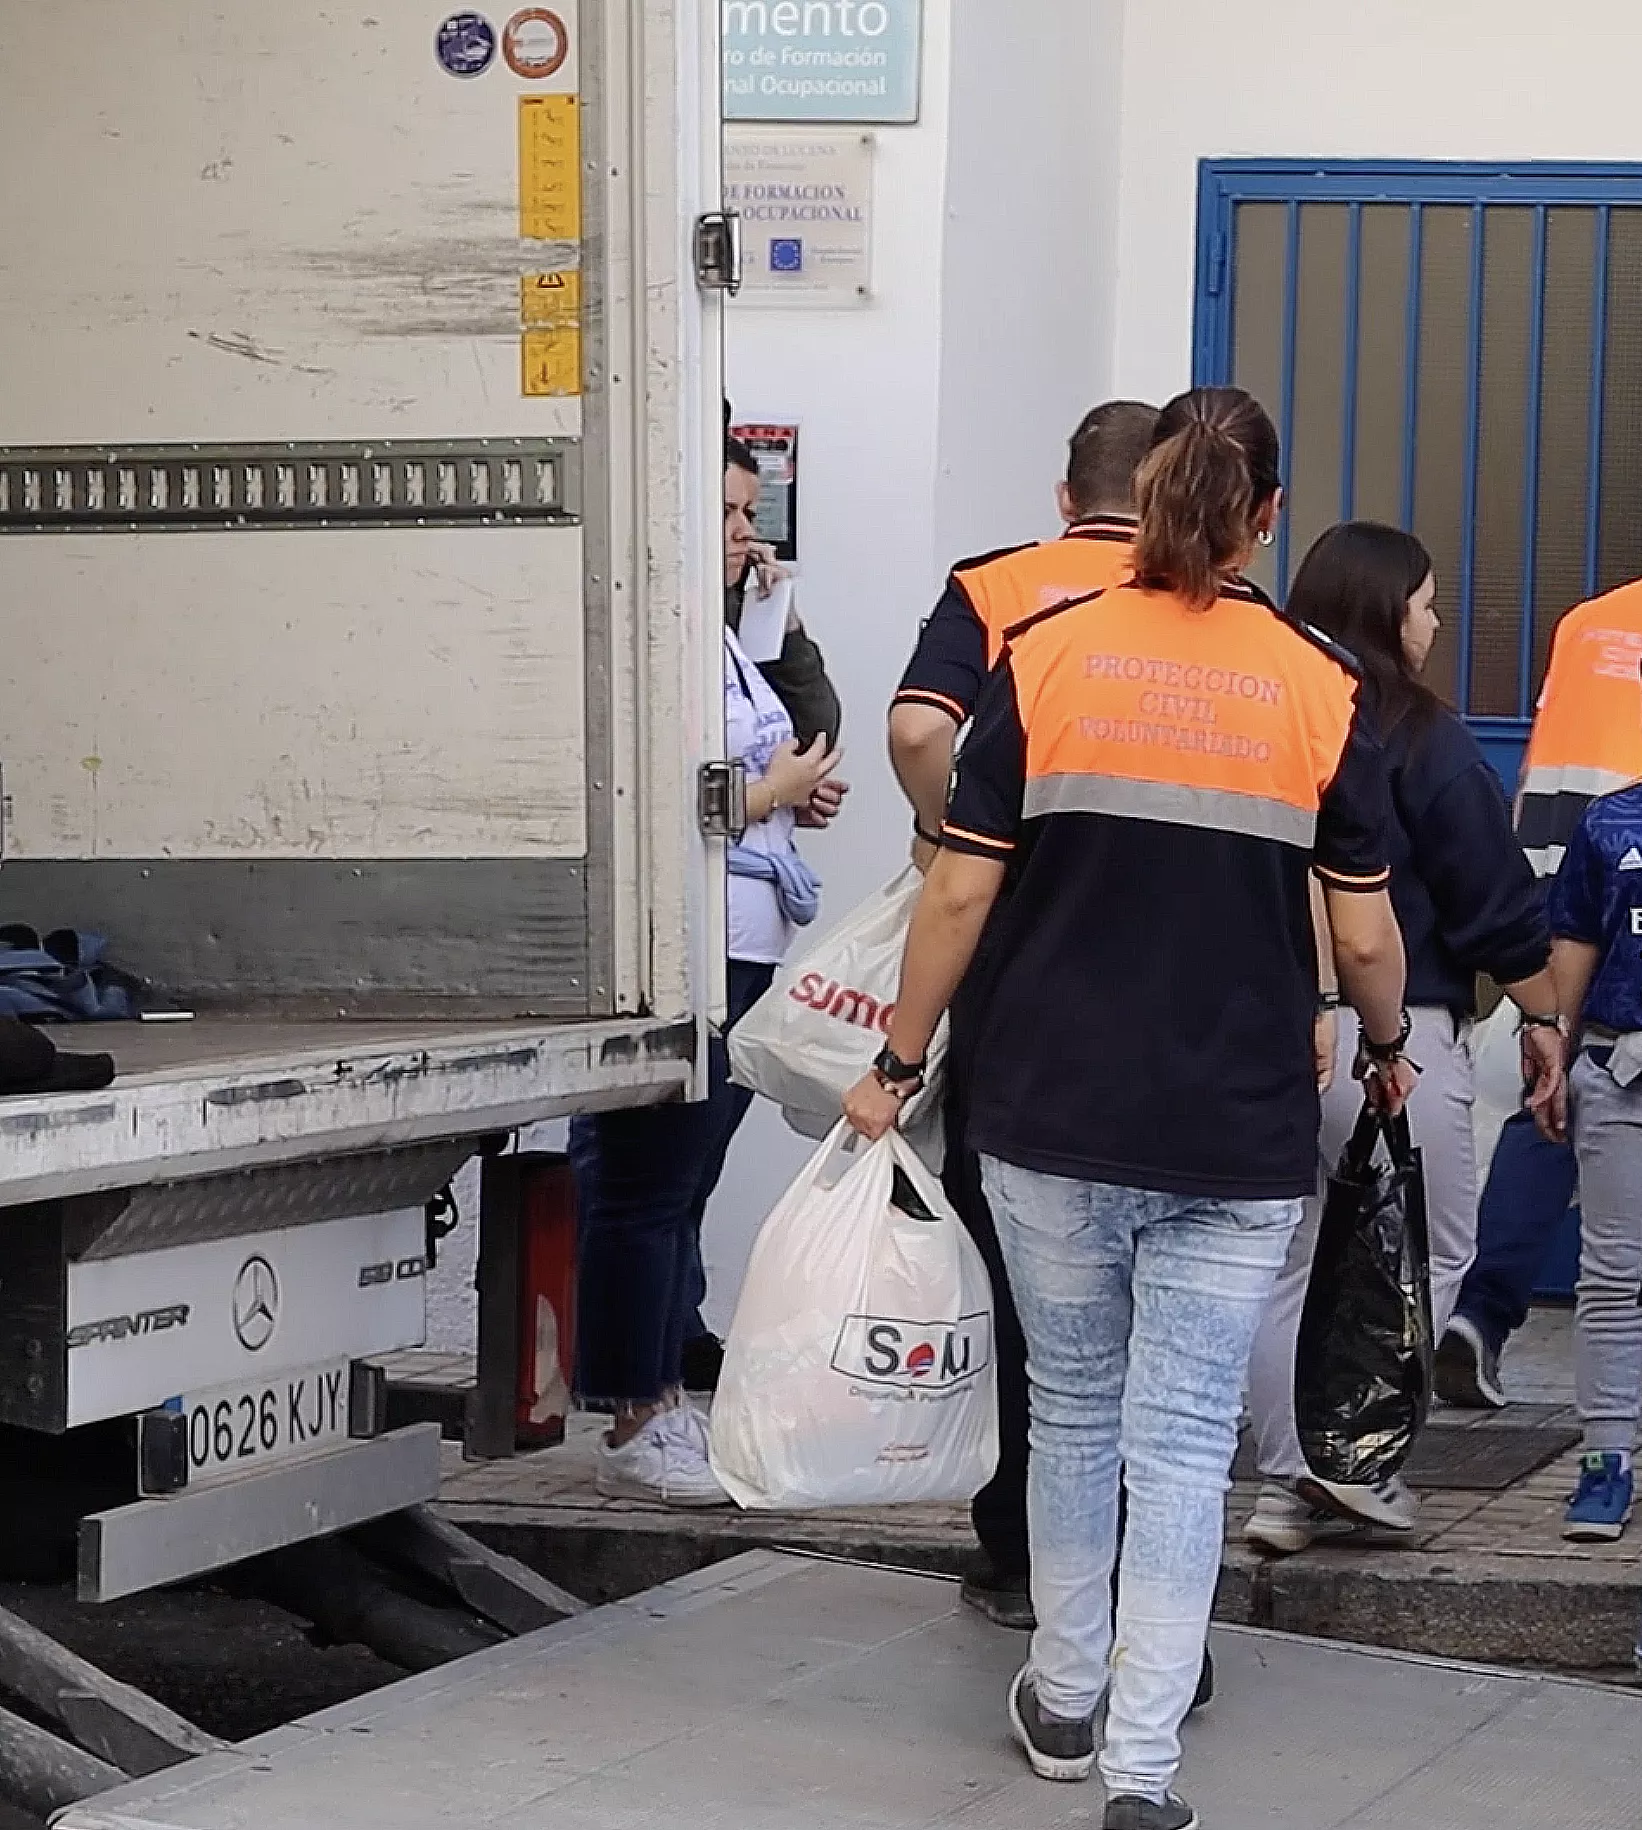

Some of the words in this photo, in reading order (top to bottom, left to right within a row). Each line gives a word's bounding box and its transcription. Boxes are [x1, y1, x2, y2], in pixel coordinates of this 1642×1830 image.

[750, 45, 777, 67] de
[780, 45, 888, 67] Formación
[760, 73, 888, 99] Ocupacional
[744, 183, 845, 200] FORMACION
[743, 206, 863, 221] OCUPACIONAL
[1083, 654, 1283, 706] PROTECCION
[1138, 690, 1218, 725] CIVIL
[190, 1388, 278, 1468] 0626
[288, 1368, 342, 1444] KJY
